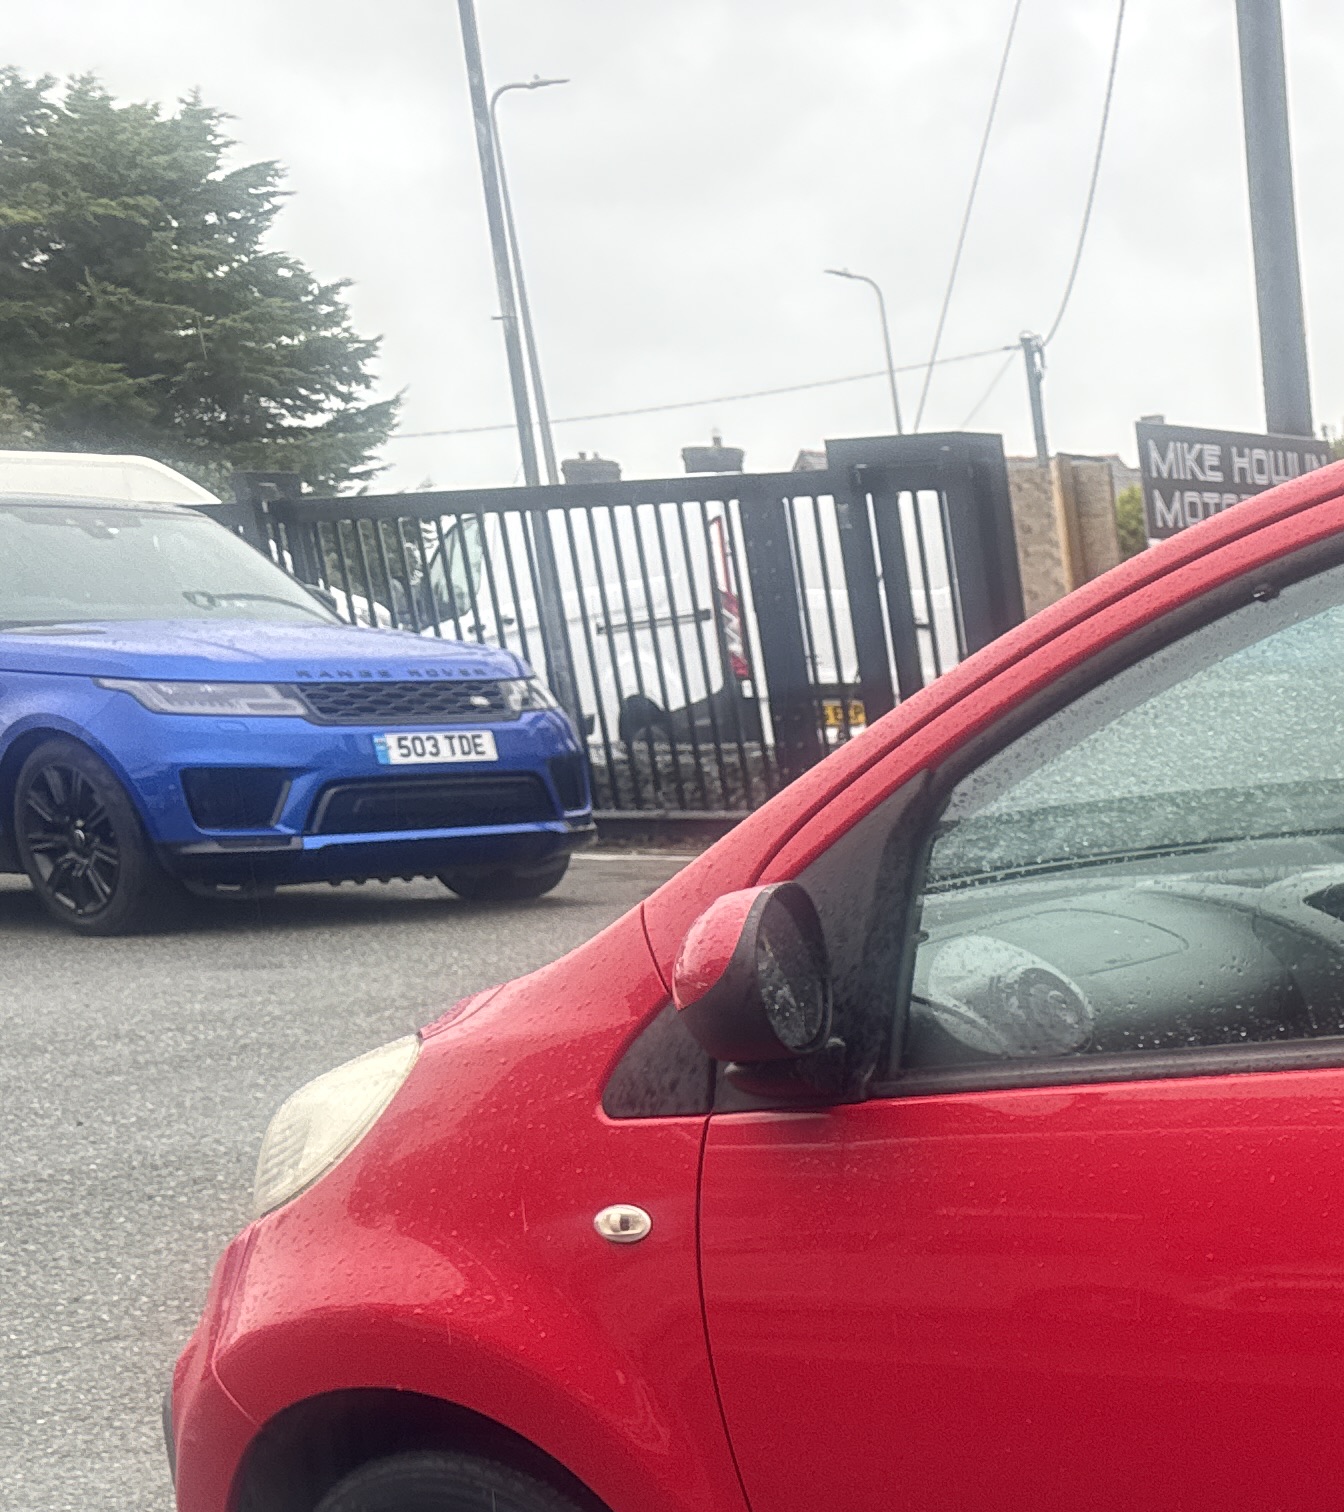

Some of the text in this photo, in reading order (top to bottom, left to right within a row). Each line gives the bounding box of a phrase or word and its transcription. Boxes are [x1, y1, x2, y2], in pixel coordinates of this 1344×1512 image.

[1147, 438, 1225, 483] MIKE
[296, 667, 487, 679] RANGE ROVER
[397, 733, 487, 759] 503 TDE
